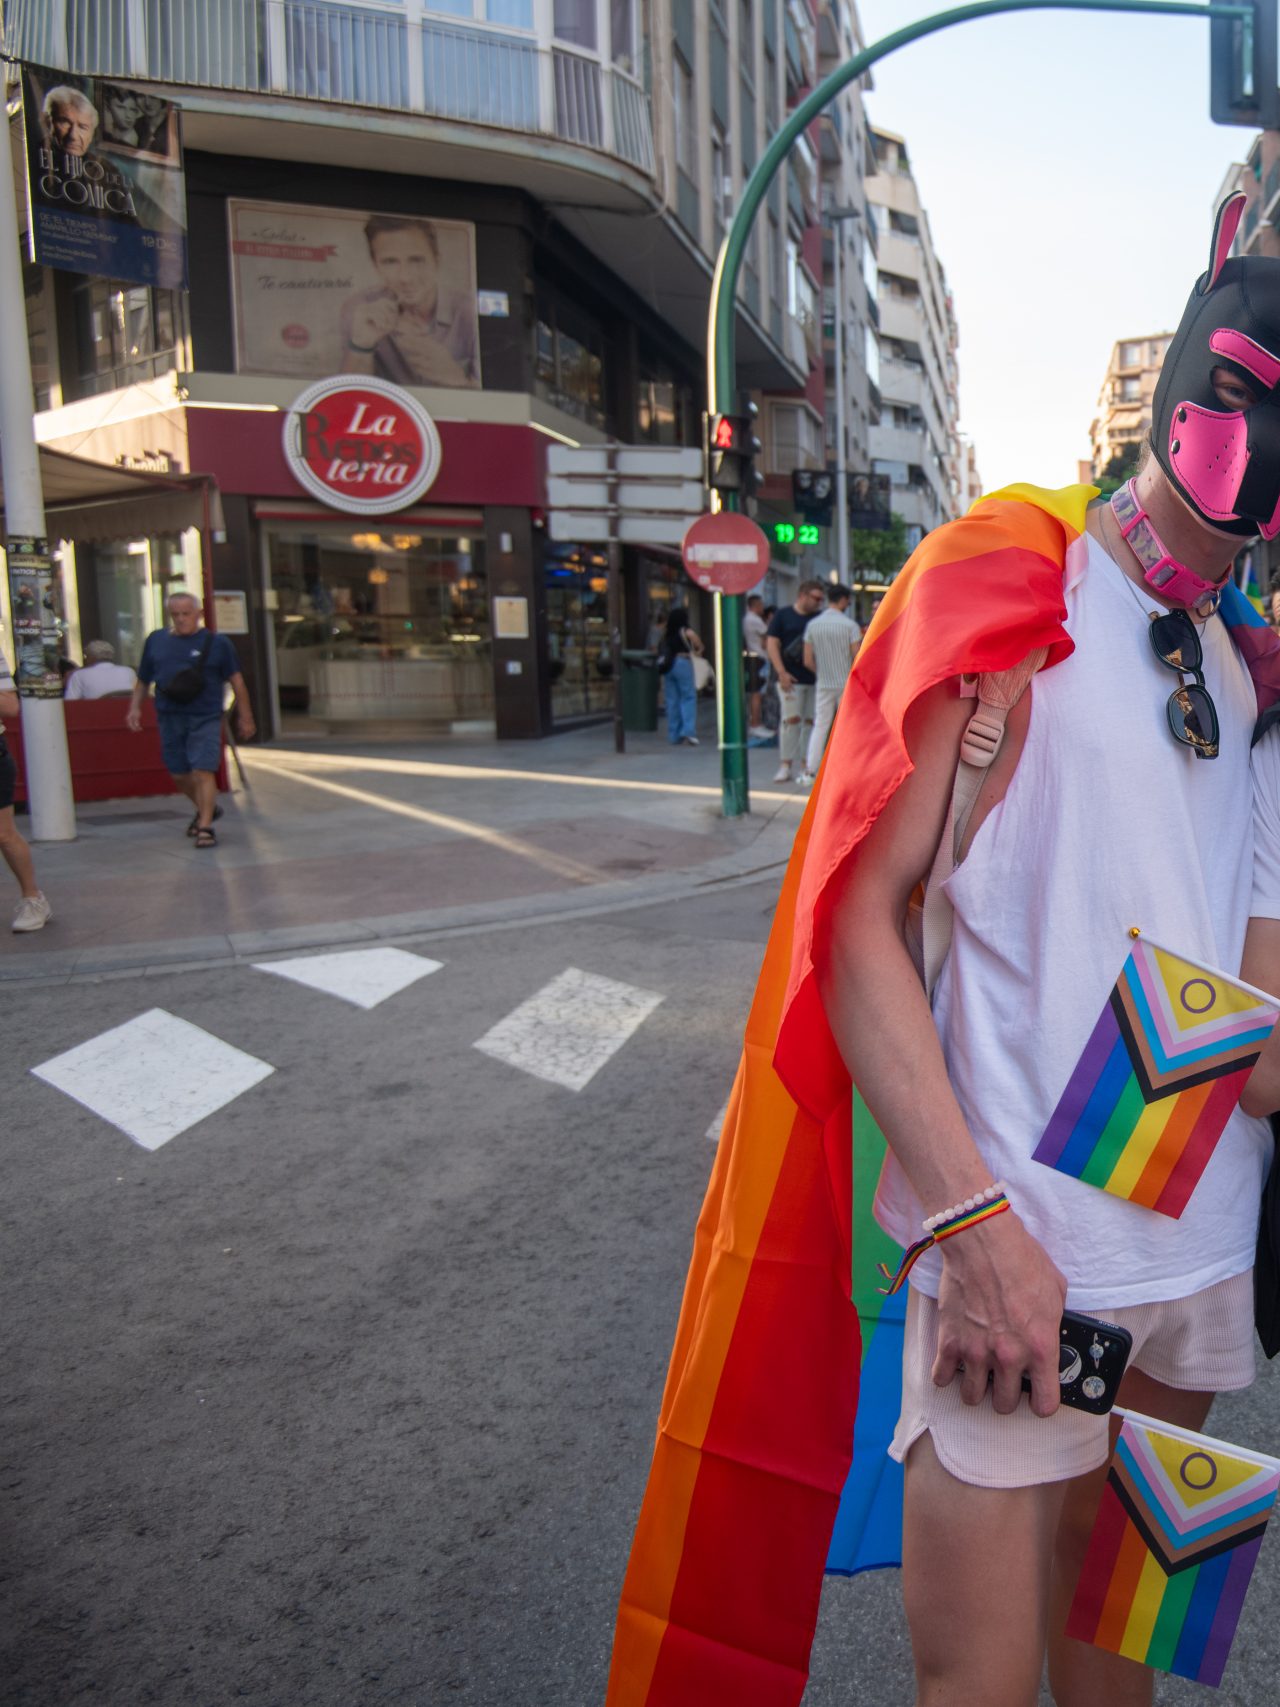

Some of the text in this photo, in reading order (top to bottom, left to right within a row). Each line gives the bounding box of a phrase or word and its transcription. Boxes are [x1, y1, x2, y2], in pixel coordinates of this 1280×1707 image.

[38, 147, 59, 172] EL
[64, 153, 105, 180] HIJO
[141, 235, 155, 249] 19
[345, 402, 397, 436] La
[298, 411, 417, 474] Repos
[326, 452, 410, 485] tería
